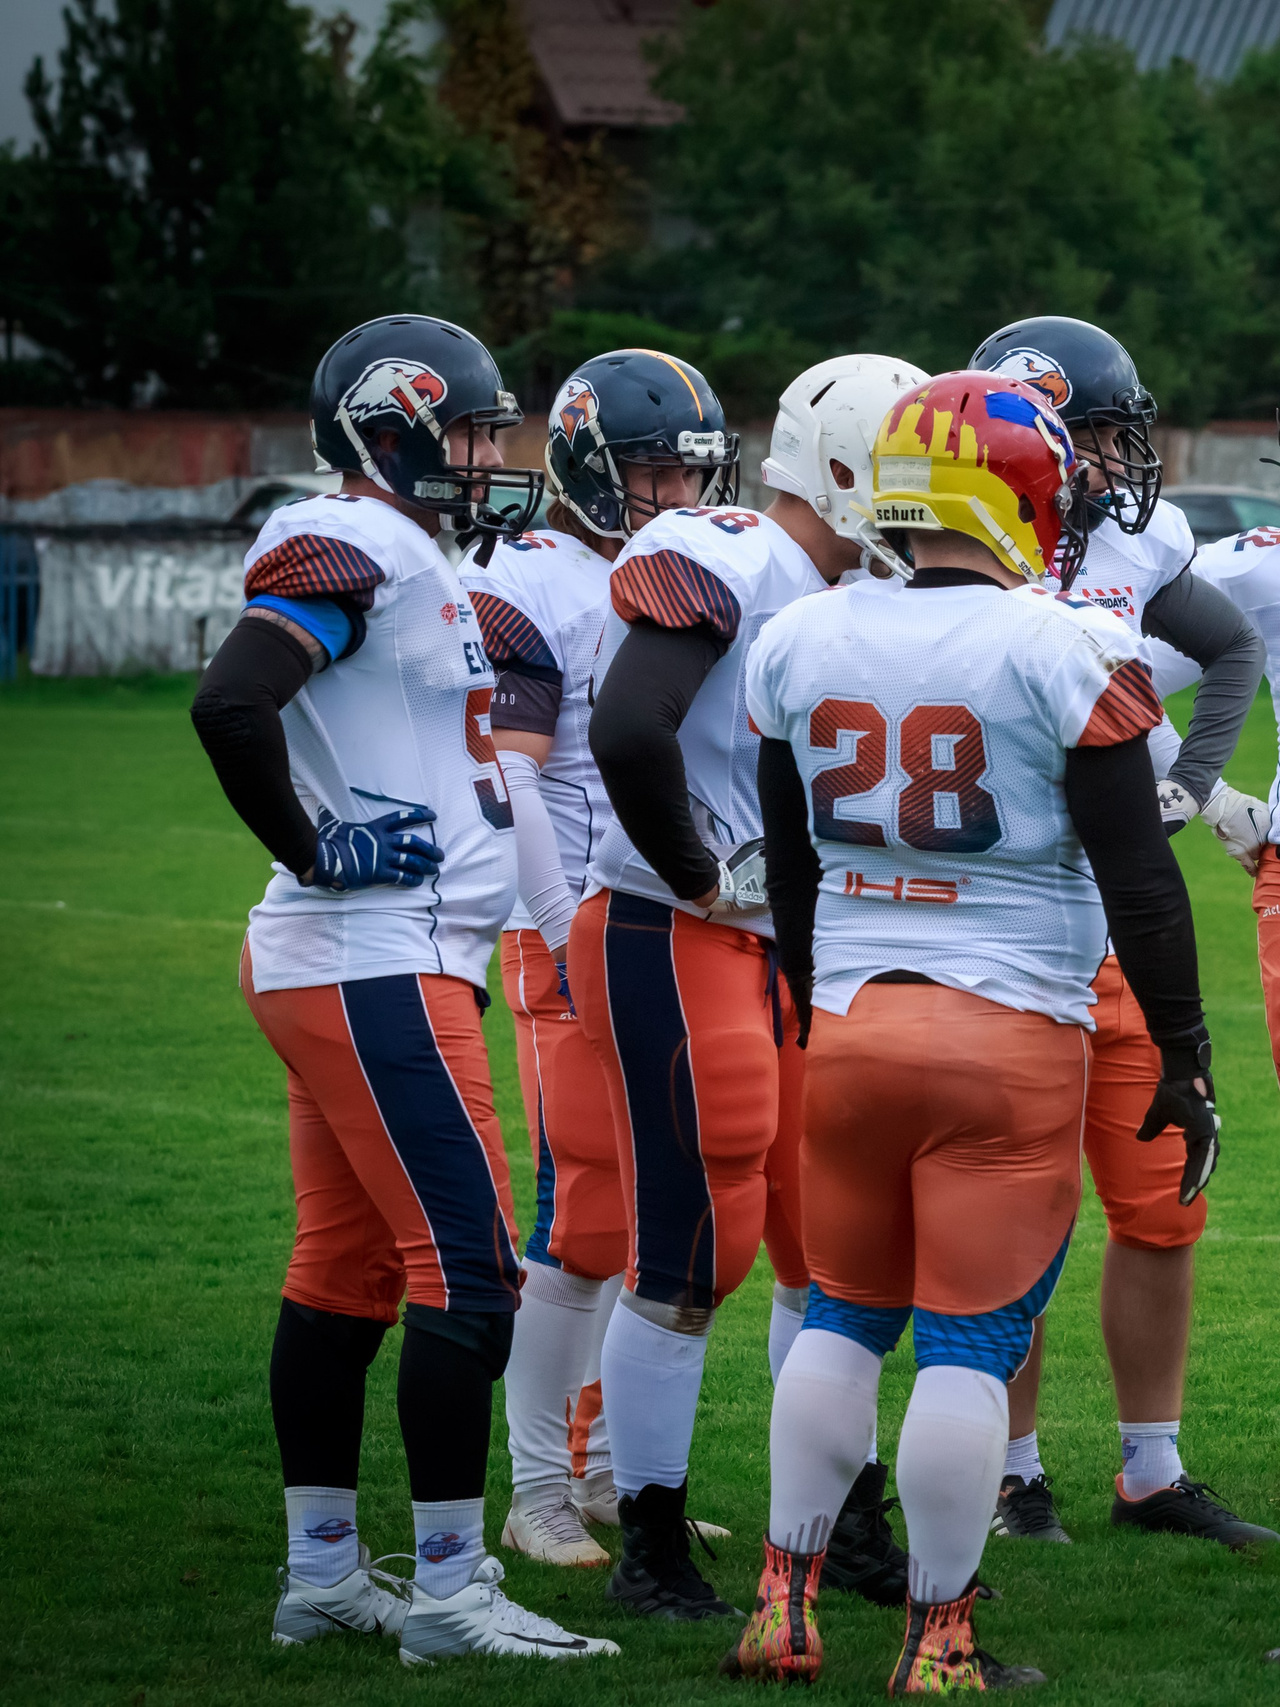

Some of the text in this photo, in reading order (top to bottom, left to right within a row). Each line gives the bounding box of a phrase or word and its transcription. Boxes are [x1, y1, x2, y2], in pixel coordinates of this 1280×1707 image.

[693, 436, 713, 445] schutt
[876, 505, 925, 521] schutt
[808, 695, 1004, 856] 28
[737, 889, 764, 901] adidas
